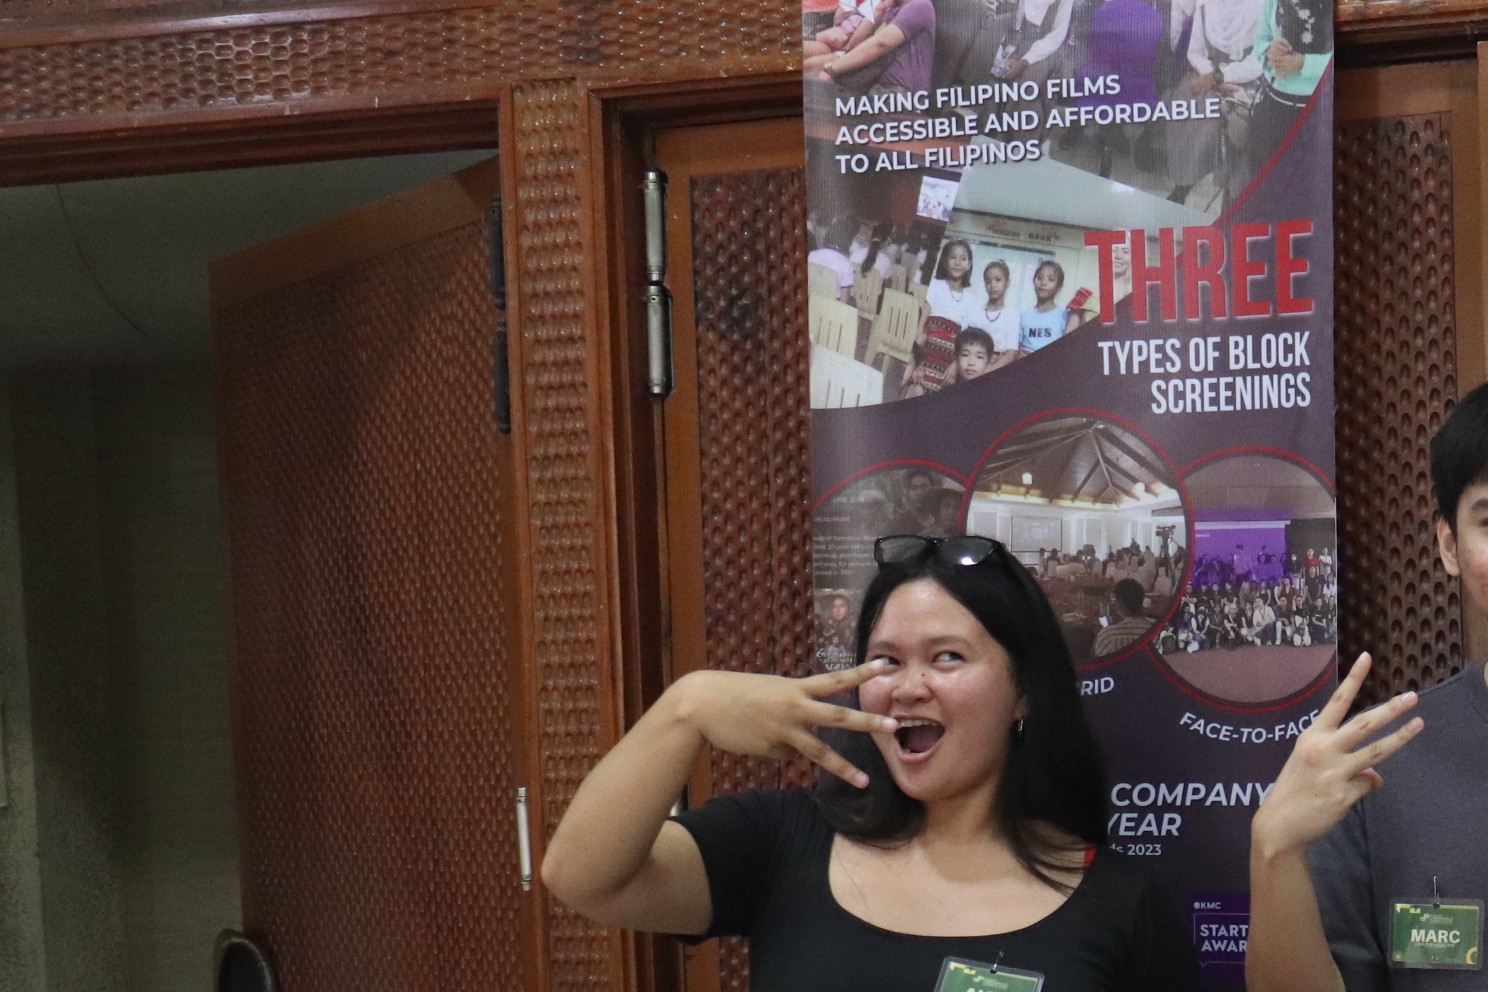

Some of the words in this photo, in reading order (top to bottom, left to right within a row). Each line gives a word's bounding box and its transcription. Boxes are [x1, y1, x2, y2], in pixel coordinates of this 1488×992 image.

[834, 88, 930, 117] MAKING
[935, 80, 1040, 109] FILIPINO
[1045, 74, 1121, 100] FILMS
[834, 116, 978, 146] ACCESSIBLE
[984, 110, 1040, 135] AND
[1045, 97, 1221, 130] AFFORDABLE
[835, 153, 869, 174] TO
[875, 148, 918, 172] ALL
[924, 139, 1041, 168] FILIPINOS
[1083, 217, 1314, 324] THREE
[1028, 327, 1052, 338] NES
[1098, 338, 1182, 376] TYPES
[1188, 336, 1222, 371] OF
[1229, 331, 1311, 370] BLOCK
[1151, 372, 1311, 414] SCREENINGS
[1111, 782, 1276, 807] COMPANY
[1127, 844, 1162, 856] 2023
[1200, 901, 1222, 910] KMC
[1200, 924, 1249, 938] START
[1410, 929, 1461, 944] MARC
[1201, 939, 1249, 953] AWAR
